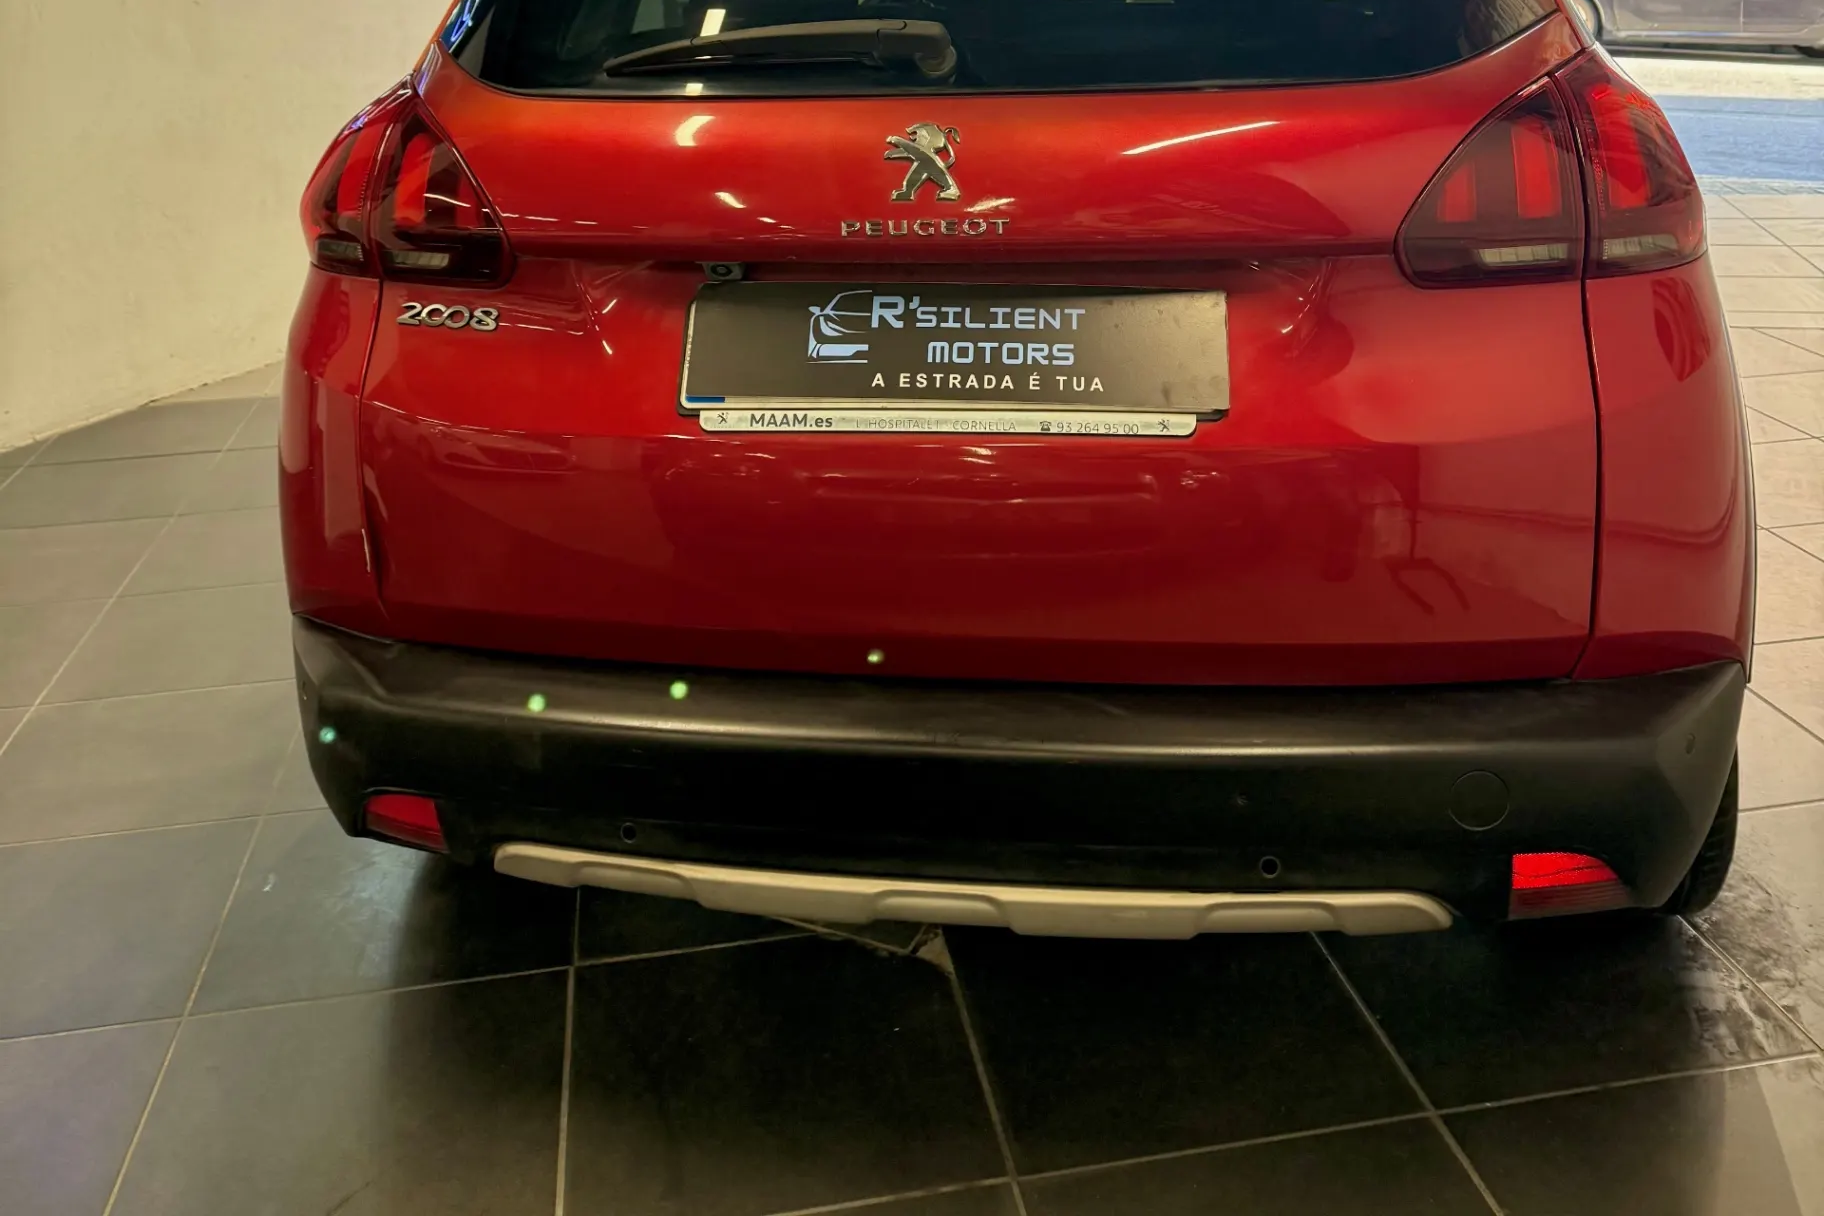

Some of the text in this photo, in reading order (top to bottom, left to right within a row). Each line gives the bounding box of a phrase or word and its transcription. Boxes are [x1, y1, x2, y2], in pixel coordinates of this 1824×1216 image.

[841, 217, 1010, 236] PEUGEOT
[396, 301, 500, 331] 2008
[871, 295, 1086, 330] R'SILIENT
[927, 341, 1075, 365] MOTORS
[871, 371, 1104, 392] A ESTRADA É TUA
[749, 412, 833, 429] MAAM.es
[952, 420, 1017, 432] CORNELLA
[1056, 421, 1072, 433] 93
[1076, 421, 1100, 434] 264
[1103, 422, 1119, 434] 95
[1123, 423, 1139, 435] 00
